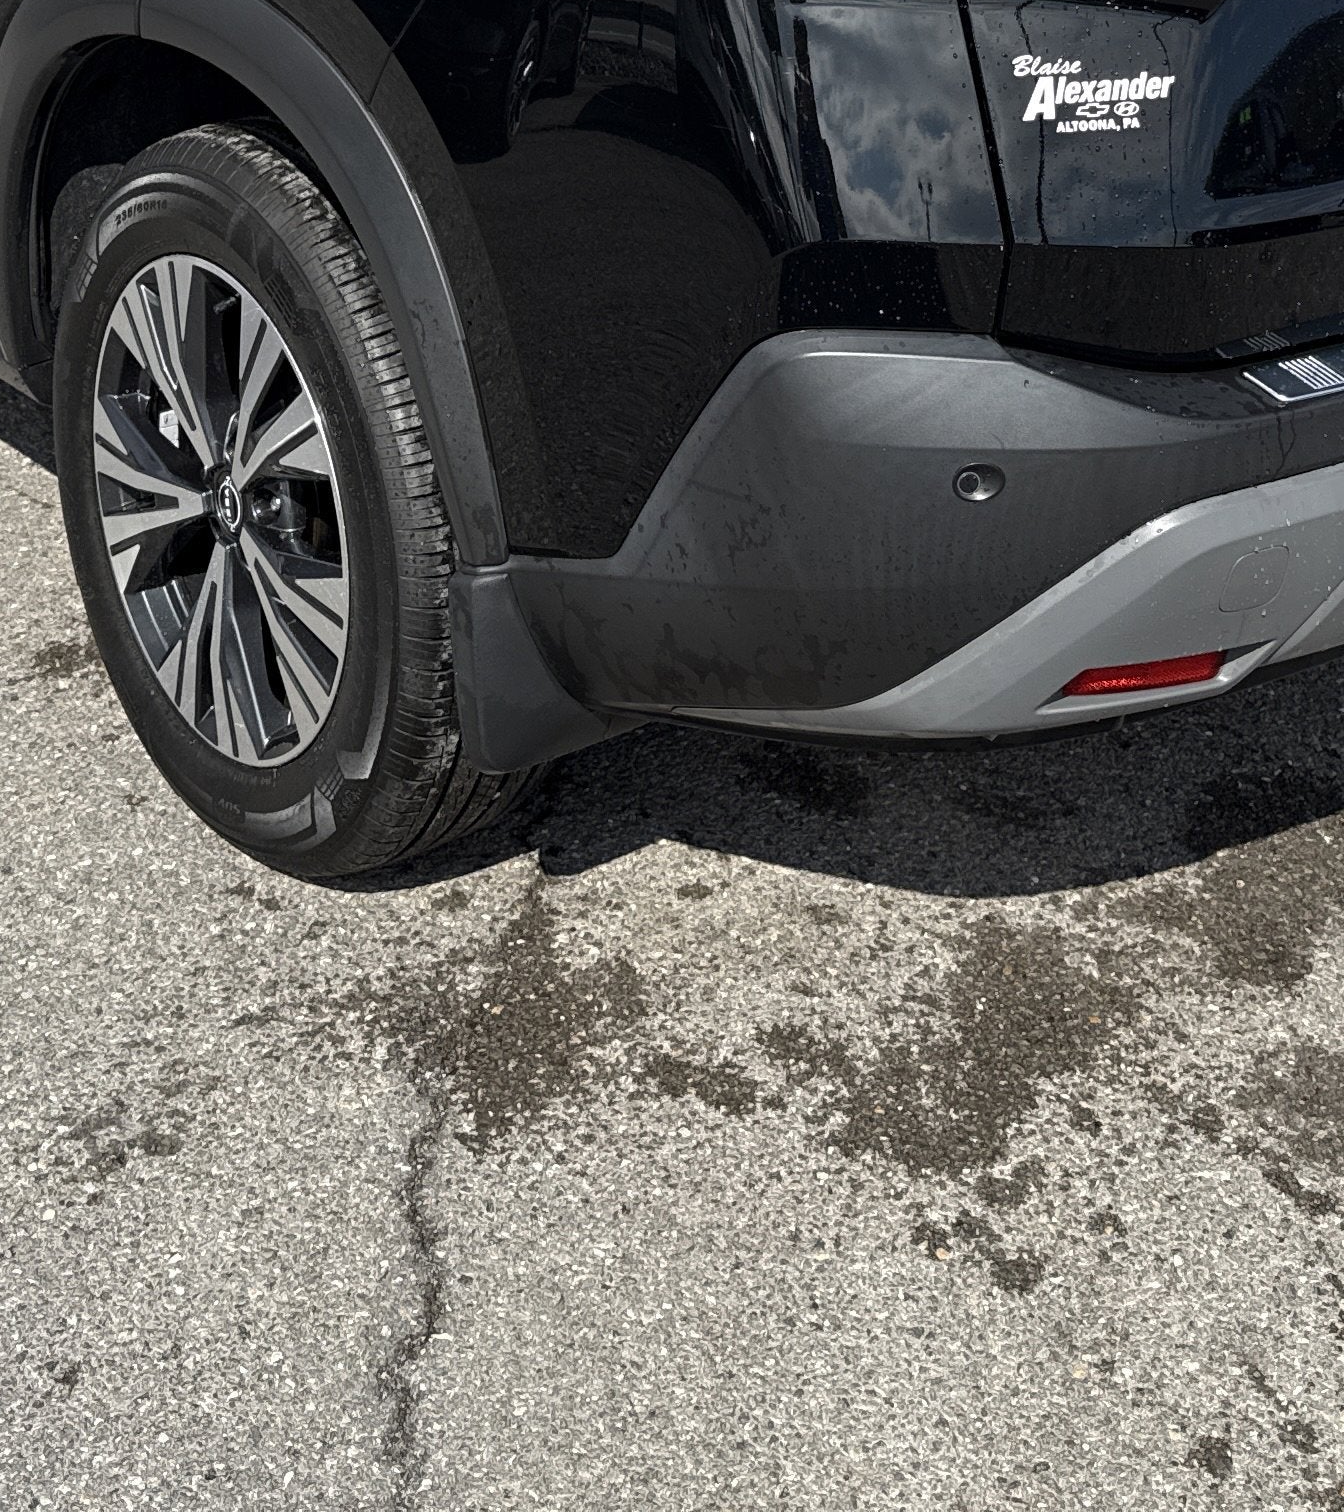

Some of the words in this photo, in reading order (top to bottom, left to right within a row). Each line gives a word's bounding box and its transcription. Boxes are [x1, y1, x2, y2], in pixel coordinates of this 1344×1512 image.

[1012, 55, 1081, 77] Blaise
[1023, 71, 1175, 121] Alexander
[1056, 119, 1121, 133] ALTOONA,
[1123, 117, 1141, 129] PA
